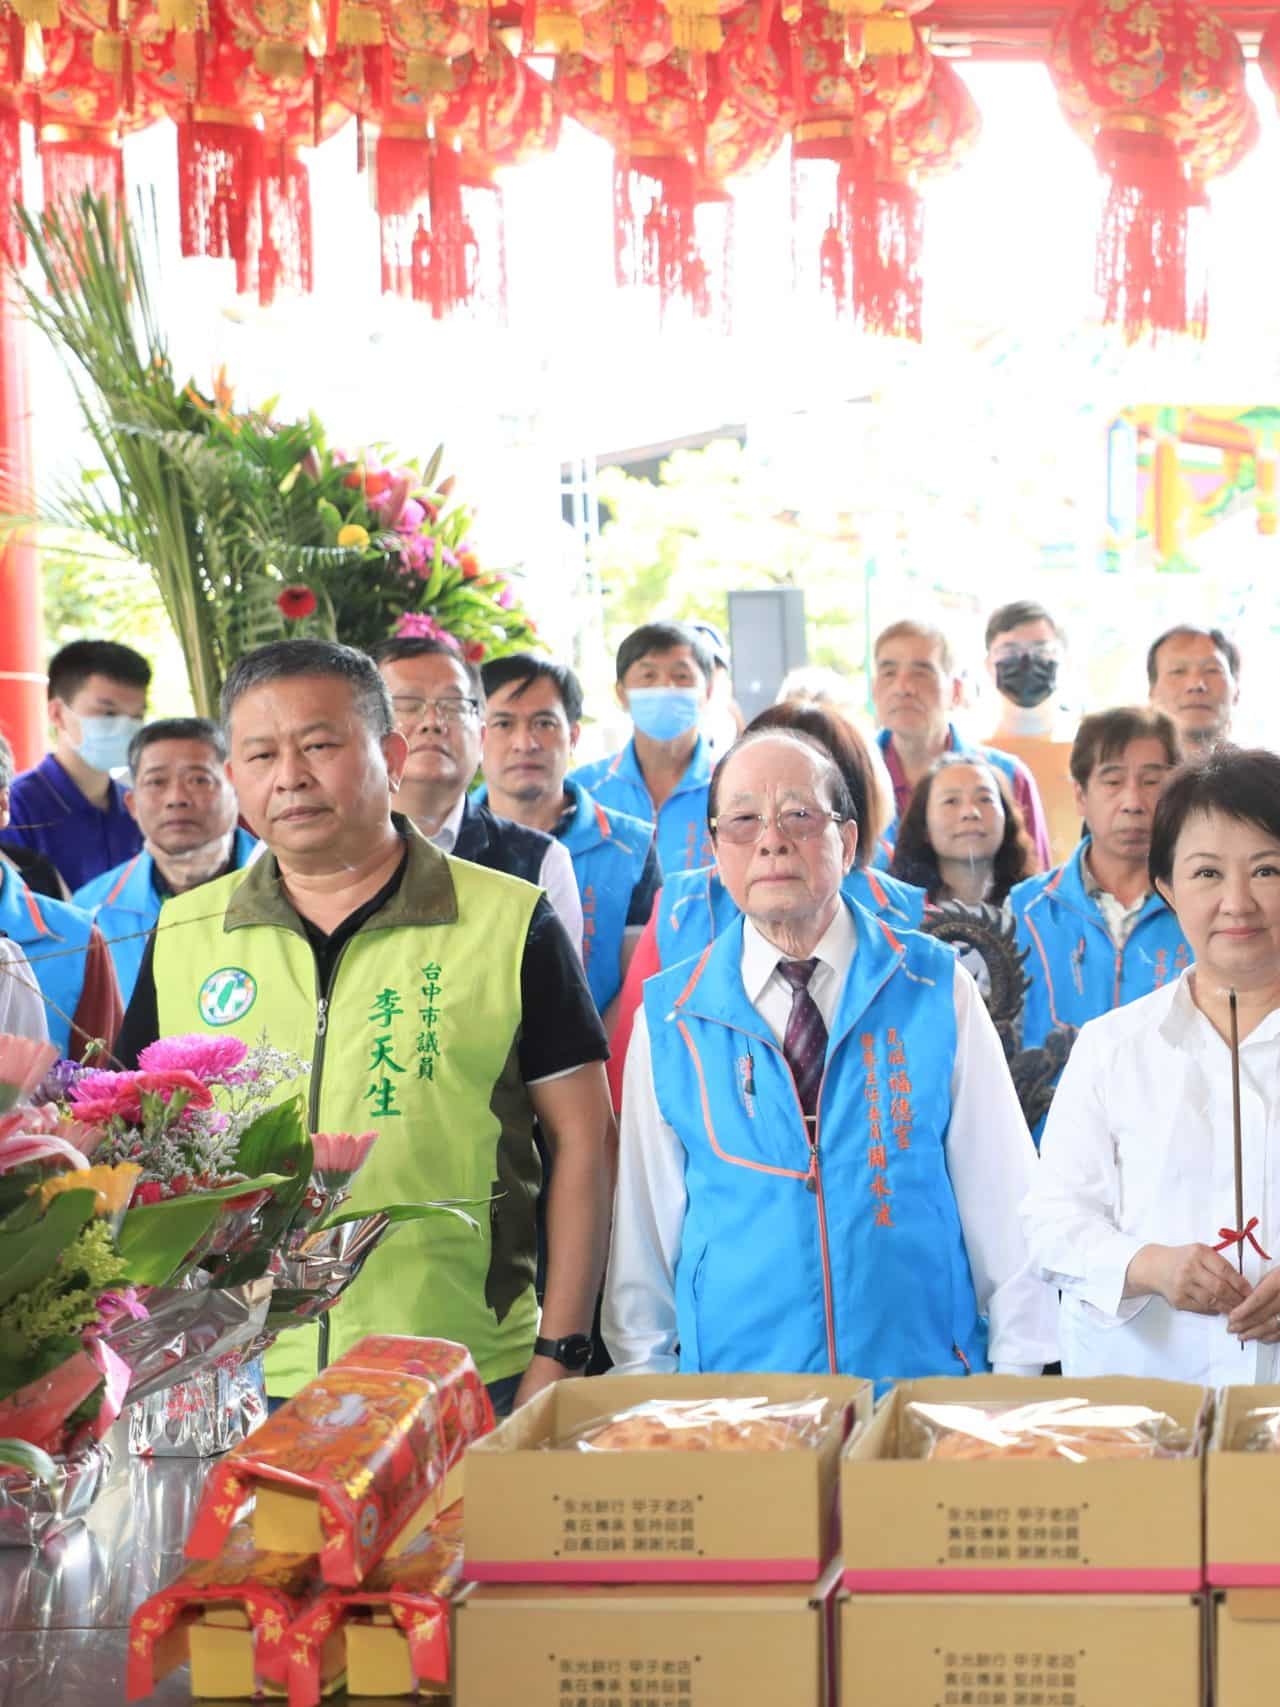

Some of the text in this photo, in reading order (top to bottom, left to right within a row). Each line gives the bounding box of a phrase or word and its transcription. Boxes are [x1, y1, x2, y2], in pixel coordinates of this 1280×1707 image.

[363, 988, 407, 1117] 李天生
[416, 962, 442, 1081] 台中市議員
